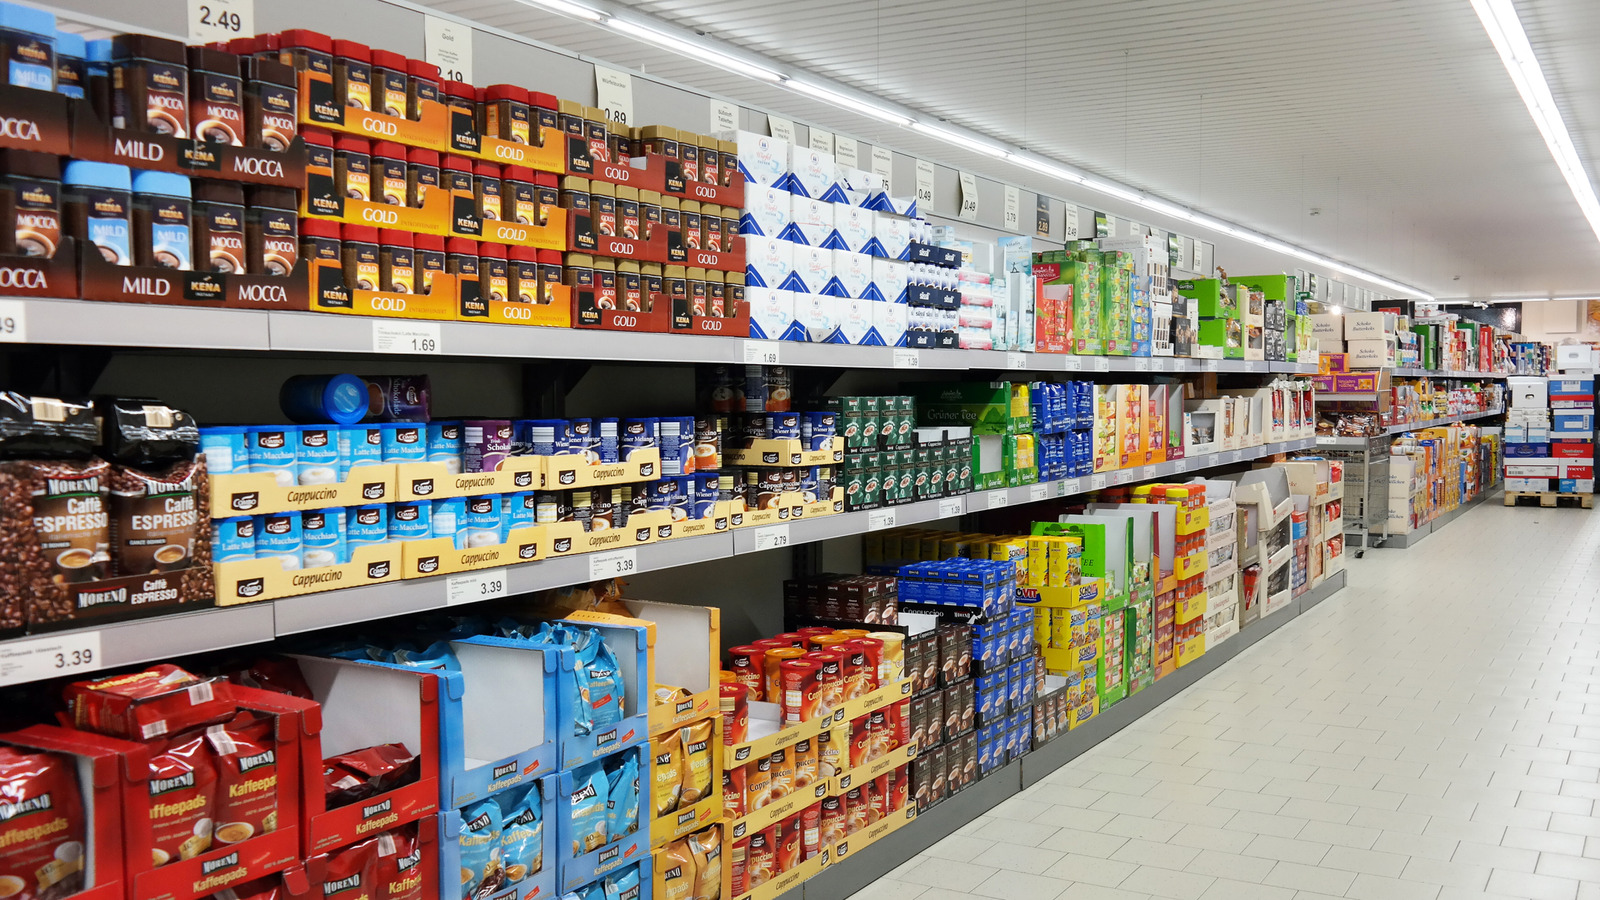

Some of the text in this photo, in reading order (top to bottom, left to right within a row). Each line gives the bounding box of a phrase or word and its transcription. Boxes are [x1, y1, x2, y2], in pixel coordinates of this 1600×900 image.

[200, 6, 241, 32] 2.49
[441, 33, 455, 42] Gold
[14, 68, 50, 85] MILD
[153, 72, 179, 87] KENA
[211, 85, 235, 98] KENA
[350, 83, 368, 93] GOLD
[148, 95, 184, 111] MOCCA
[267, 95, 290, 109] KENA
[387, 92, 405, 102] GOLD
[207, 105, 239, 121] MOCCA
[314, 104, 340, 118] KENA
[263, 115, 293, 131] MOCCA
[362, 117, 398, 136] GOLD
[456, 134, 477, 147] KENA
[114, 138, 164, 163] MILD
[184, 149, 215, 164] KENA
[495, 145, 525, 161] GOLD
[234, 156, 284, 179] MOCCA
[573, 157, 591, 169] KENA
[349, 174, 368, 184] GOLD
[604, 166, 630, 181] GOLD
[385, 180, 405, 190] GOLD
[668, 179, 683, 189] KENA
[22, 189, 52, 204] KENA
[695, 186, 717, 199] GOLD
[919, 188, 931, 201] 0.49
[95, 201, 123, 214] KENA
[313, 198, 339, 210] KENA
[965, 199, 976, 211] 0.49
[159, 208, 184, 220] KENA
[215, 215, 237, 227] KENA
[363, 207, 398, 225] GOLD
[17, 213, 57, 230] MOCCA
[269, 219, 291, 232] KENA
[457, 218, 479, 230] KENA
[1038, 221, 1048, 232] 2.89
[93, 224, 126, 239] MILD
[157, 229, 187, 244] MILD
[497, 227, 527, 242] GOLD
[211, 236, 242, 250] MOCCA
[265, 239, 294, 254] MOCCA
[578, 234, 595, 245] KENA
[610, 241, 634, 255] GOLD
[671, 249, 685, 258] KENA
[698, 254, 718, 266] GOLD
[123, 275, 170, 297] MILD
[191, 281, 221, 294] KENA
[239, 285, 287, 303] MOCCA
[323, 290, 349, 302] KENA
[371, 297, 406, 312] GOLD
[465, 301, 486, 311] KENA
[503, 307, 531, 320] GOLD
[581, 311, 599, 321] KENA
[0, 316, 15, 333] 9
[613, 315, 637, 328] GOLD
[676, 317, 690, 325] KENA
[702, 320, 722, 331] GOLD
[411, 338, 436, 352] 1.69
[763, 354, 776, 363] 1.69
[908, 358, 918, 366] 1.39
[927, 409, 977, 420] Grüner Tee
[809, 453, 826, 461] Cappuccino
[593, 467, 624, 480] Cappuccino
[48, 477, 99, 495] MORENO
[147, 480, 193, 495] MORENO
[455, 476, 495, 490] Cappuccino
[287, 488, 337, 504] Cappuccino
[67, 497, 102, 514] Caffè
[165, 498, 195, 514] Caffè
[810, 506, 827, 514] Cappuccino
[951, 506, 960, 514] 1.39
[34, 513, 108, 533] ESPRESSO
[132, 510, 197, 531] ESPRESSO
[751, 513, 771, 522] Cappuccino
[883, 517, 894, 526] 1.39
[683, 523, 706, 534] Cappuccino
[304, 532, 337, 540] Macchiato
[589, 534, 621, 548] Cappuccino
[774, 536, 787, 547] 2.79
[461, 550, 499, 565] Cappuccino
[617, 560, 633, 572] 3.39
[143, 578, 167, 592] Caffè
[292, 569, 343, 588] Cappuccino
[481, 580, 502, 595] 3.39
[78, 588, 127, 608] MORENO
[131, 588, 177, 605] ESPRESSO
[55, 649, 92, 668] 3.39
[677, 700, 692, 712] MORENO
[863, 695, 884, 708] Cappuccino
[673, 711, 697, 724] Kaffeepads
[597, 730, 617, 746] MORENO
[775, 731, 800, 746] Cappuccino
[592, 742, 621, 758] Kaffeepads
[240, 750, 274, 771] MORENO
[870, 759, 890, 774] Cappuccino
[494, 763, 517, 778] MORENO
[150, 772, 194, 794] MORENO
[488, 774, 522, 793] Kaffeepads
[363, 800, 391, 818] MORENO
[769, 802, 793, 819] Cappuccino
[356, 812, 398, 835] Kaffeepads
[679, 810, 695, 824] MORENO
[674, 821, 699, 836] Kaffeepads
[868, 823, 889, 839] Cappuccino
[600, 846, 618, 863] MORENO
[203, 852, 238, 873] MORENO
[593, 858, 623, 876] Kaffeepads
[193, 867, 248, 893] Kaffeepads
[324, 875, 359, 894] MORENO
[776, 872, 800, 891] Cappuccino
